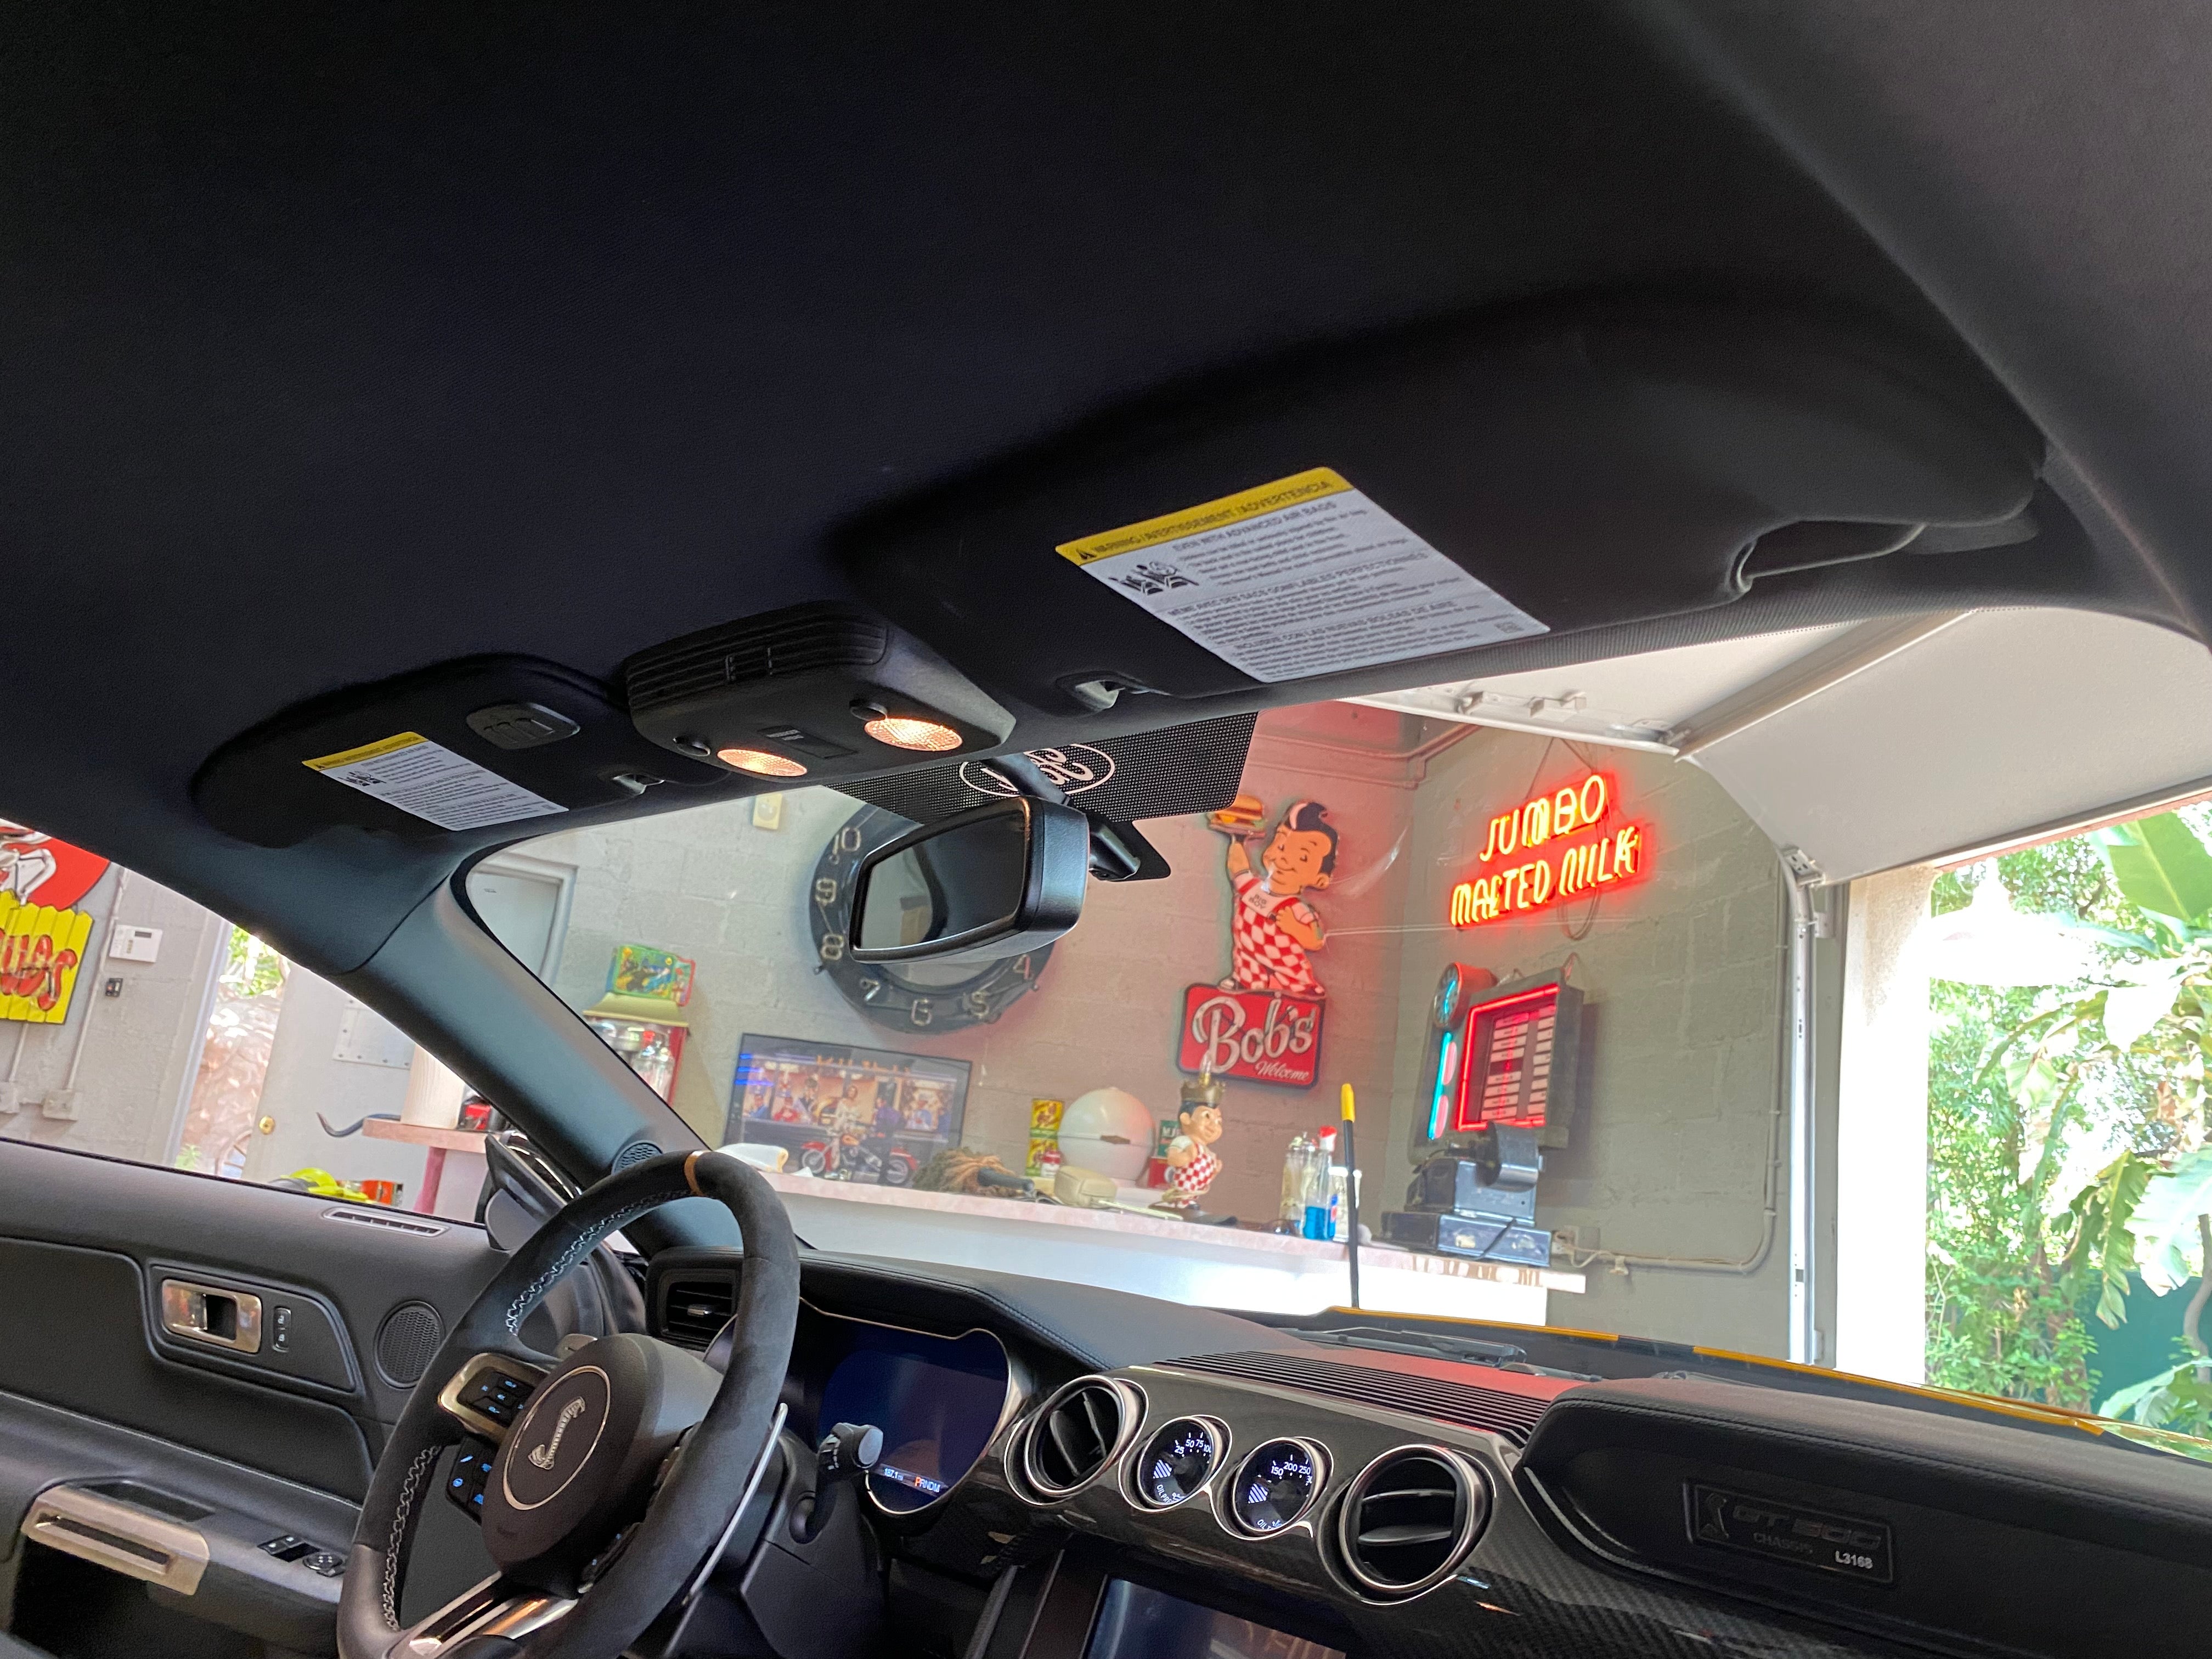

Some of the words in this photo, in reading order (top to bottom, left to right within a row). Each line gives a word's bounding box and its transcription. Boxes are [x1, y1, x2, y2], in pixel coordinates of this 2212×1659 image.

[1480, 774, 1605, 862] JUMBO
[1451, 860, 1551, 926] MALTED
[1559, 826, 1640, 895] MILK
[1249, 896, 1266, 909] BOY
[821, 934, 845, 960] 8
[911, 998, 932, 1026] 6
[1190, 995, 1317, 1075] Bob's
[1254, 1059, 1310, 1081] Welcome
[1174, 1445, 1185, 1454] 25
[1185, 1439, 1195, 1448] 50
[1195, 1439, 1204, 1448] 75
[1271, 1465, 1284, 1476] 150
[1283, 1461, 1298, 1472] 200
[1298, 1465, 1311, 1475] 250
[1257, 1519, 1267, 1530] OIL
